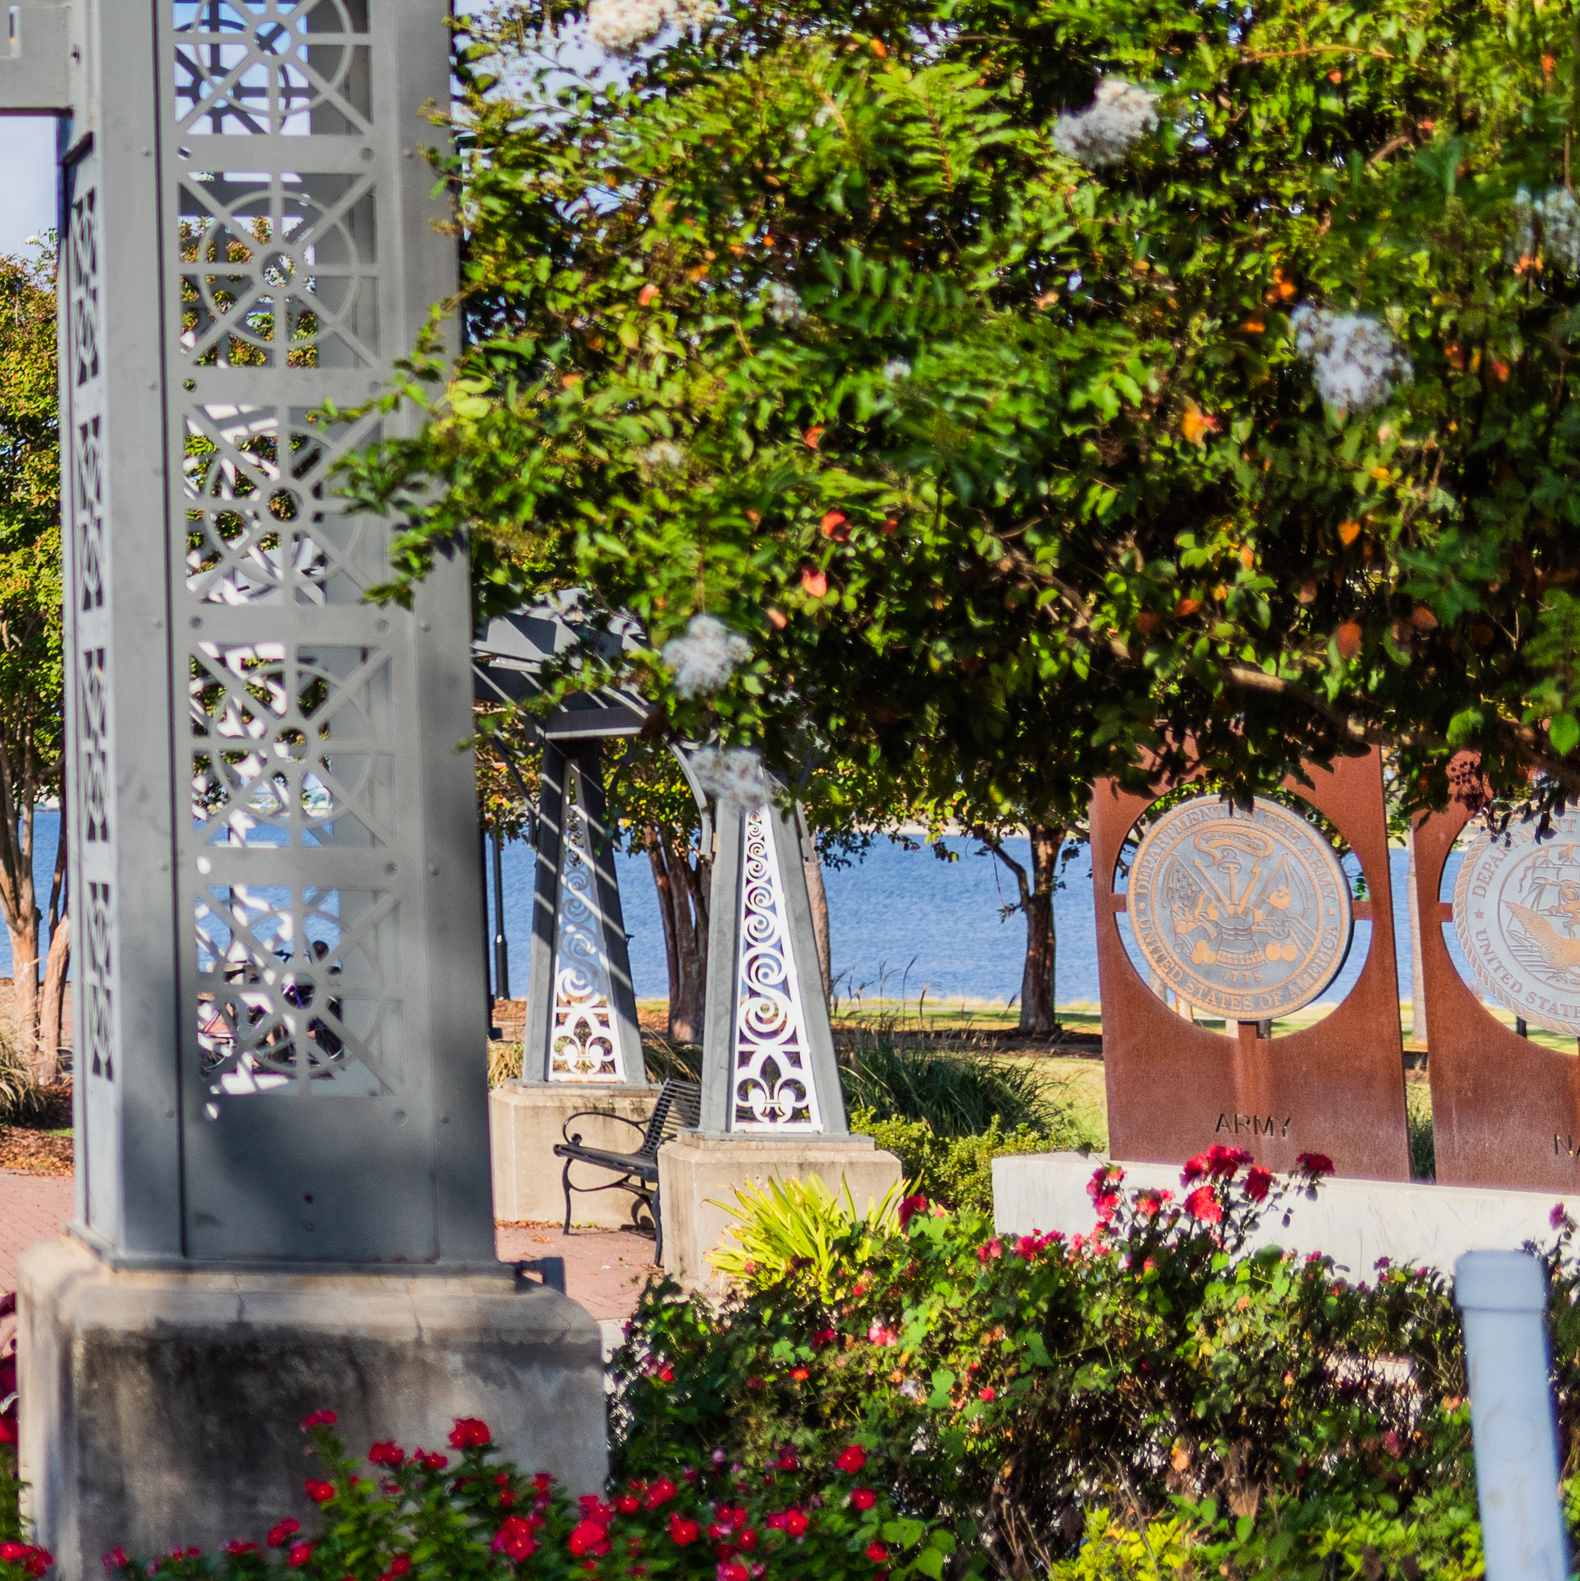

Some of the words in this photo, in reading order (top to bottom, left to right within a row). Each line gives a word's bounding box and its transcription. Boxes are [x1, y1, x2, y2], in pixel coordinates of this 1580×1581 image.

[1137, 804, 1226, 895] DEPARTMENT
[1264, 811, 1302, 845] THE
[1300, 845, 1338, 900] ARMY
[1140, 917, 1183, 982] UNITED
[1183, 979, 1253, 1011] STATES
[1259, 991, 1282, 1010] OF
[1289, 925, 1338, 1000] AMERICA
[1223, 970, 1262, 983] 1775
[1475, 928, 1523, 993] UNITED
[1215, 1112, 1292, 1137] ARMY
